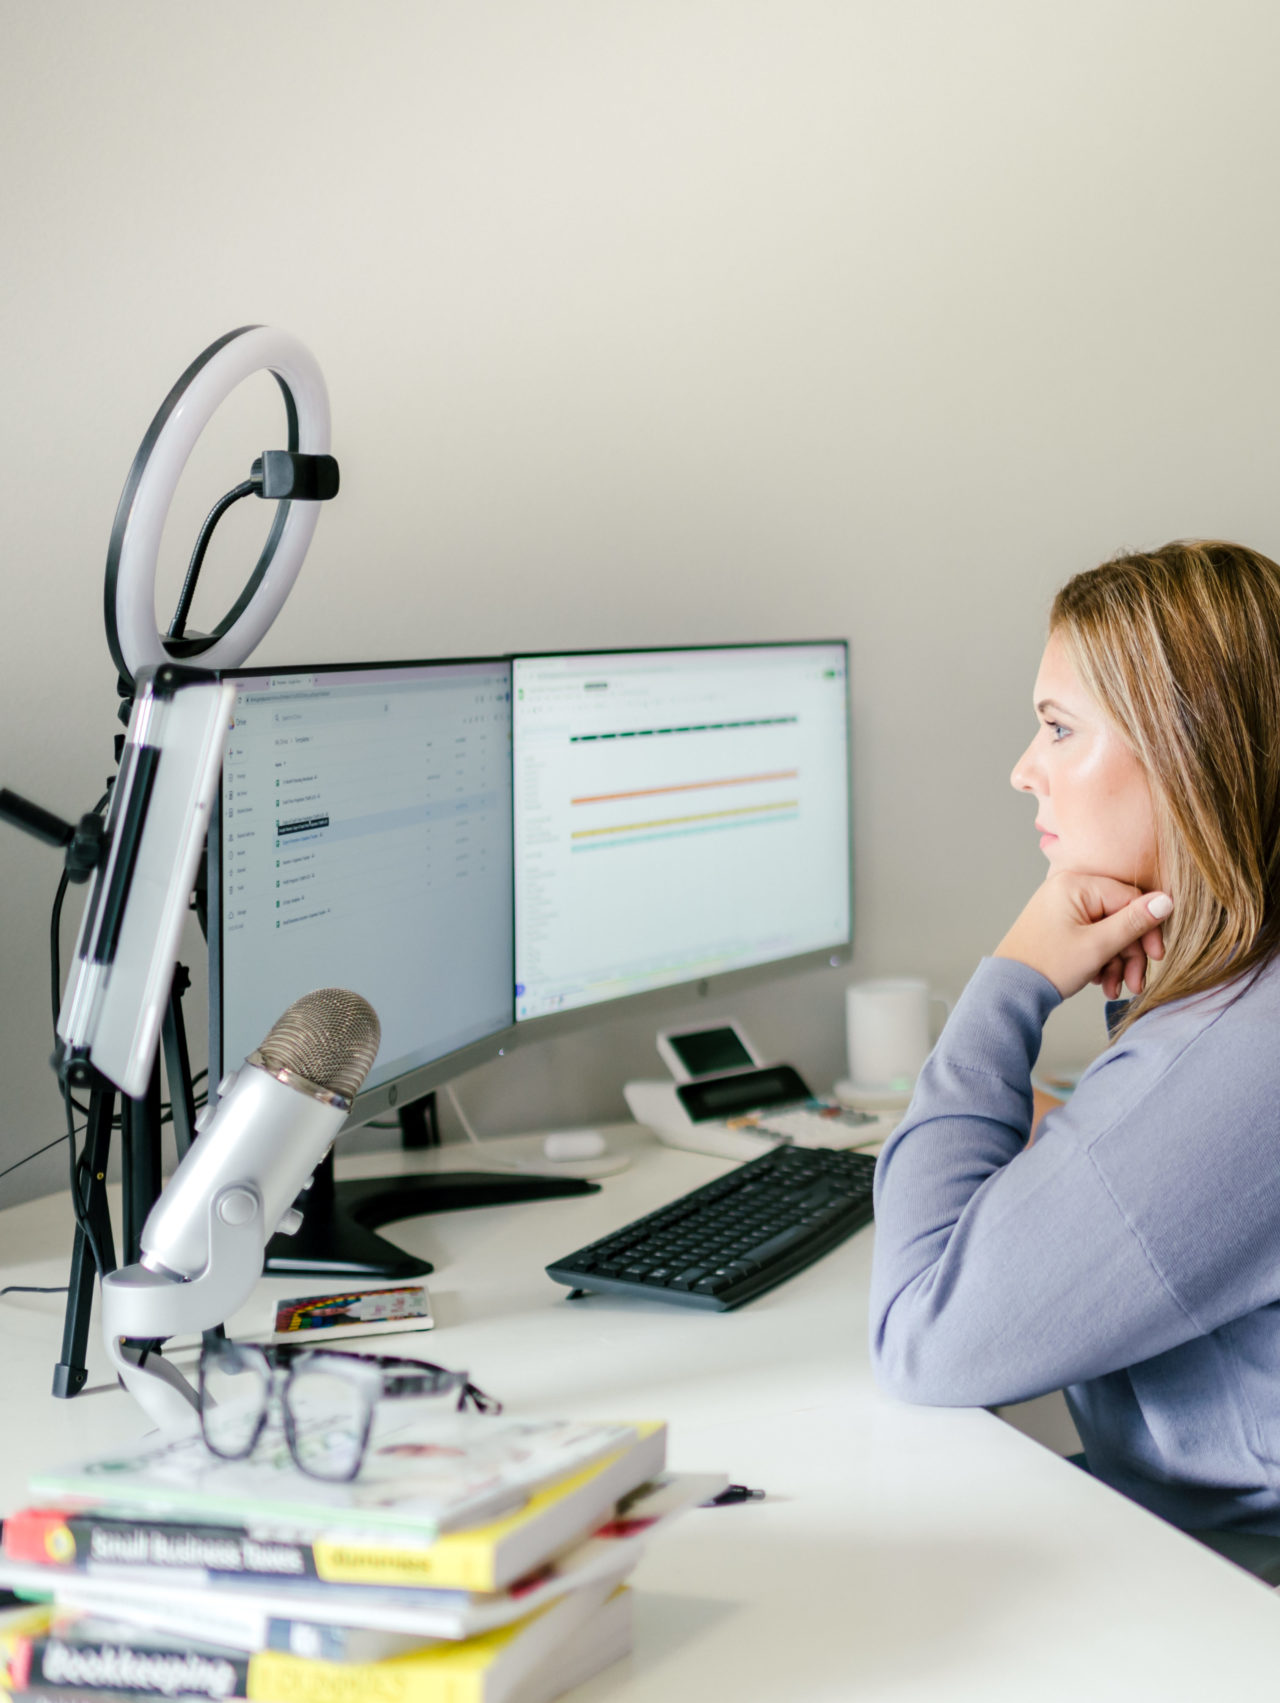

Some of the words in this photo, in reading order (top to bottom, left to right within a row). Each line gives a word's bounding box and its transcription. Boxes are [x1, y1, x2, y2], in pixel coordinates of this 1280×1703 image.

[91, 1526, 148, 1564] Small
[150, 1530, 242, 1571] Business
[42, 1639, 237, 1698] Bookkeeping
